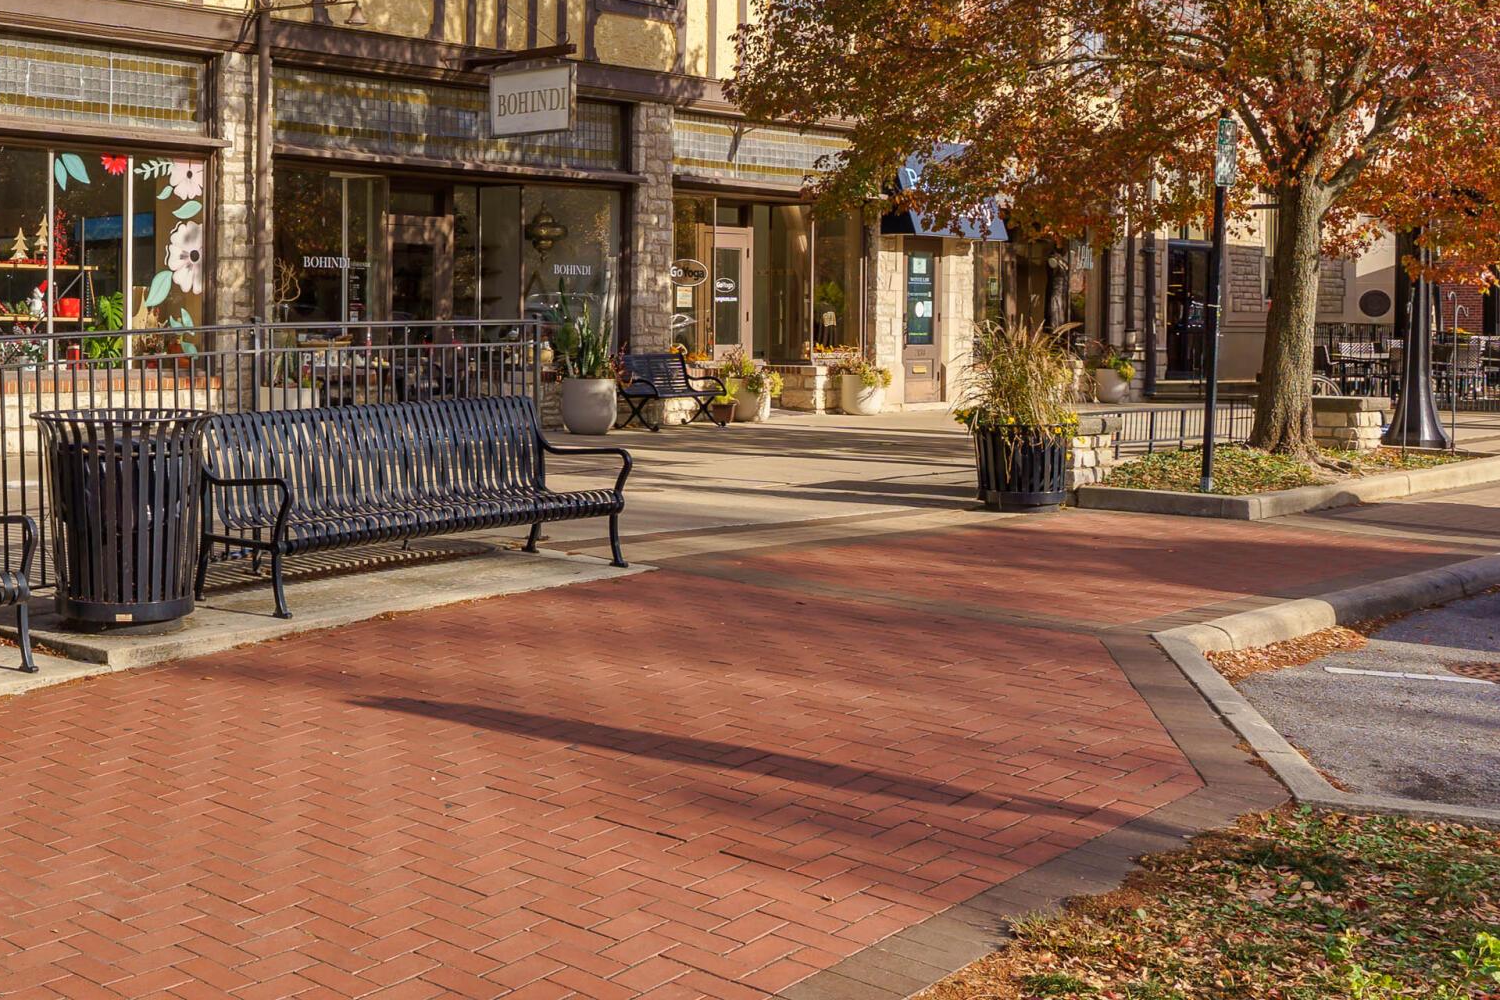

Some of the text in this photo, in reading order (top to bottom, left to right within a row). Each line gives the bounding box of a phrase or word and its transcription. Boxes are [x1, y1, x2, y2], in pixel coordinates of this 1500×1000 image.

[498, 87, 567, 117] BOHINDI
[303, 256, 351, 269] BOHINDI
[553, 264, 591, 275] BOHINDI
